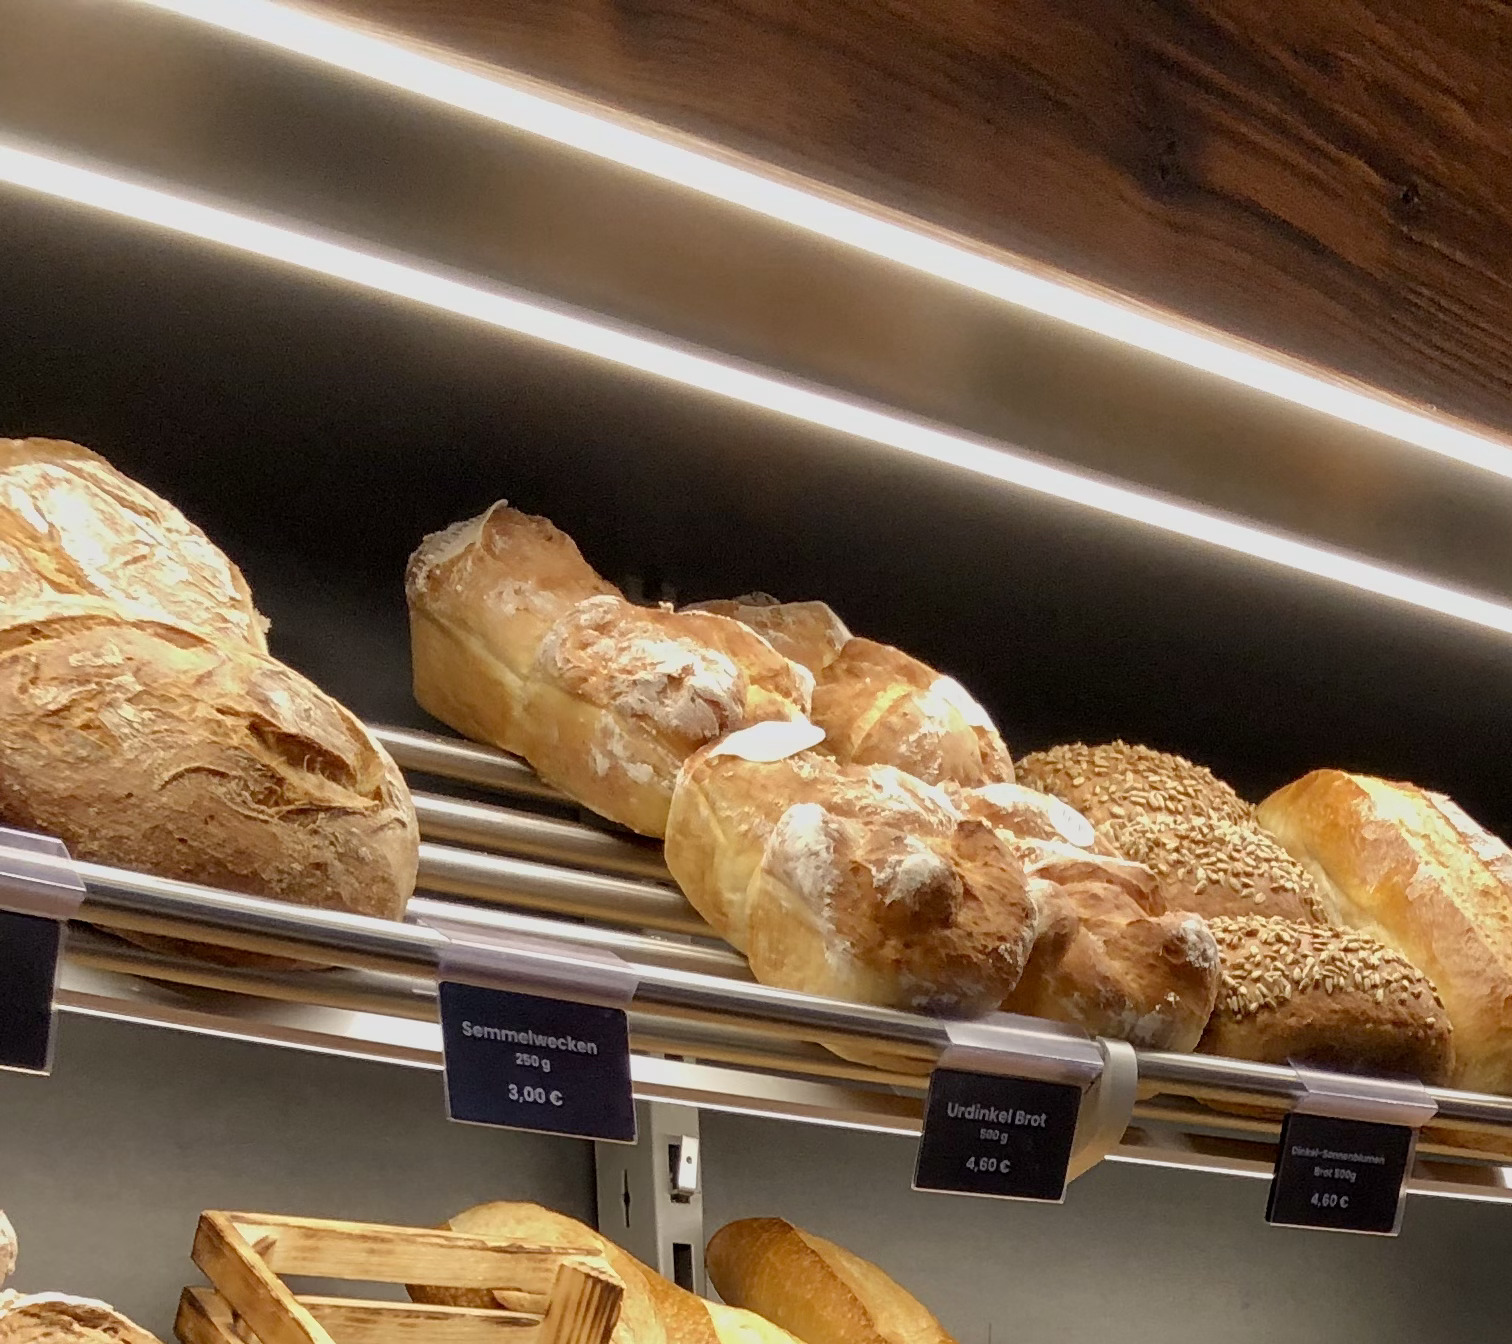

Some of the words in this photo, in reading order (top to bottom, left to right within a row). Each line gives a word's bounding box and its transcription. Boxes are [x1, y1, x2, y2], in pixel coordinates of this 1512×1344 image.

[461, 1020, 598, 1055] Semmelwecken
[515, 1052, 539, 1067] 250
[541, 1059, 551, 1073] g
[508, 1083, 546, 1103] 3,00
[550, 1090, 564, 1106] €
[947, 1102, 1013, 1124] Urdinkel
[1015, 1110, 1047, 1128] Brot
[966, 1156, 997, 1172] 4,60
[1000, 1159, 1011, 1173] €
[1313, 1166, 1333, 1178] Brot
[1310, 1193, 1338, 1208] 4,60
[1340, 1195, 1349, 1208] €
